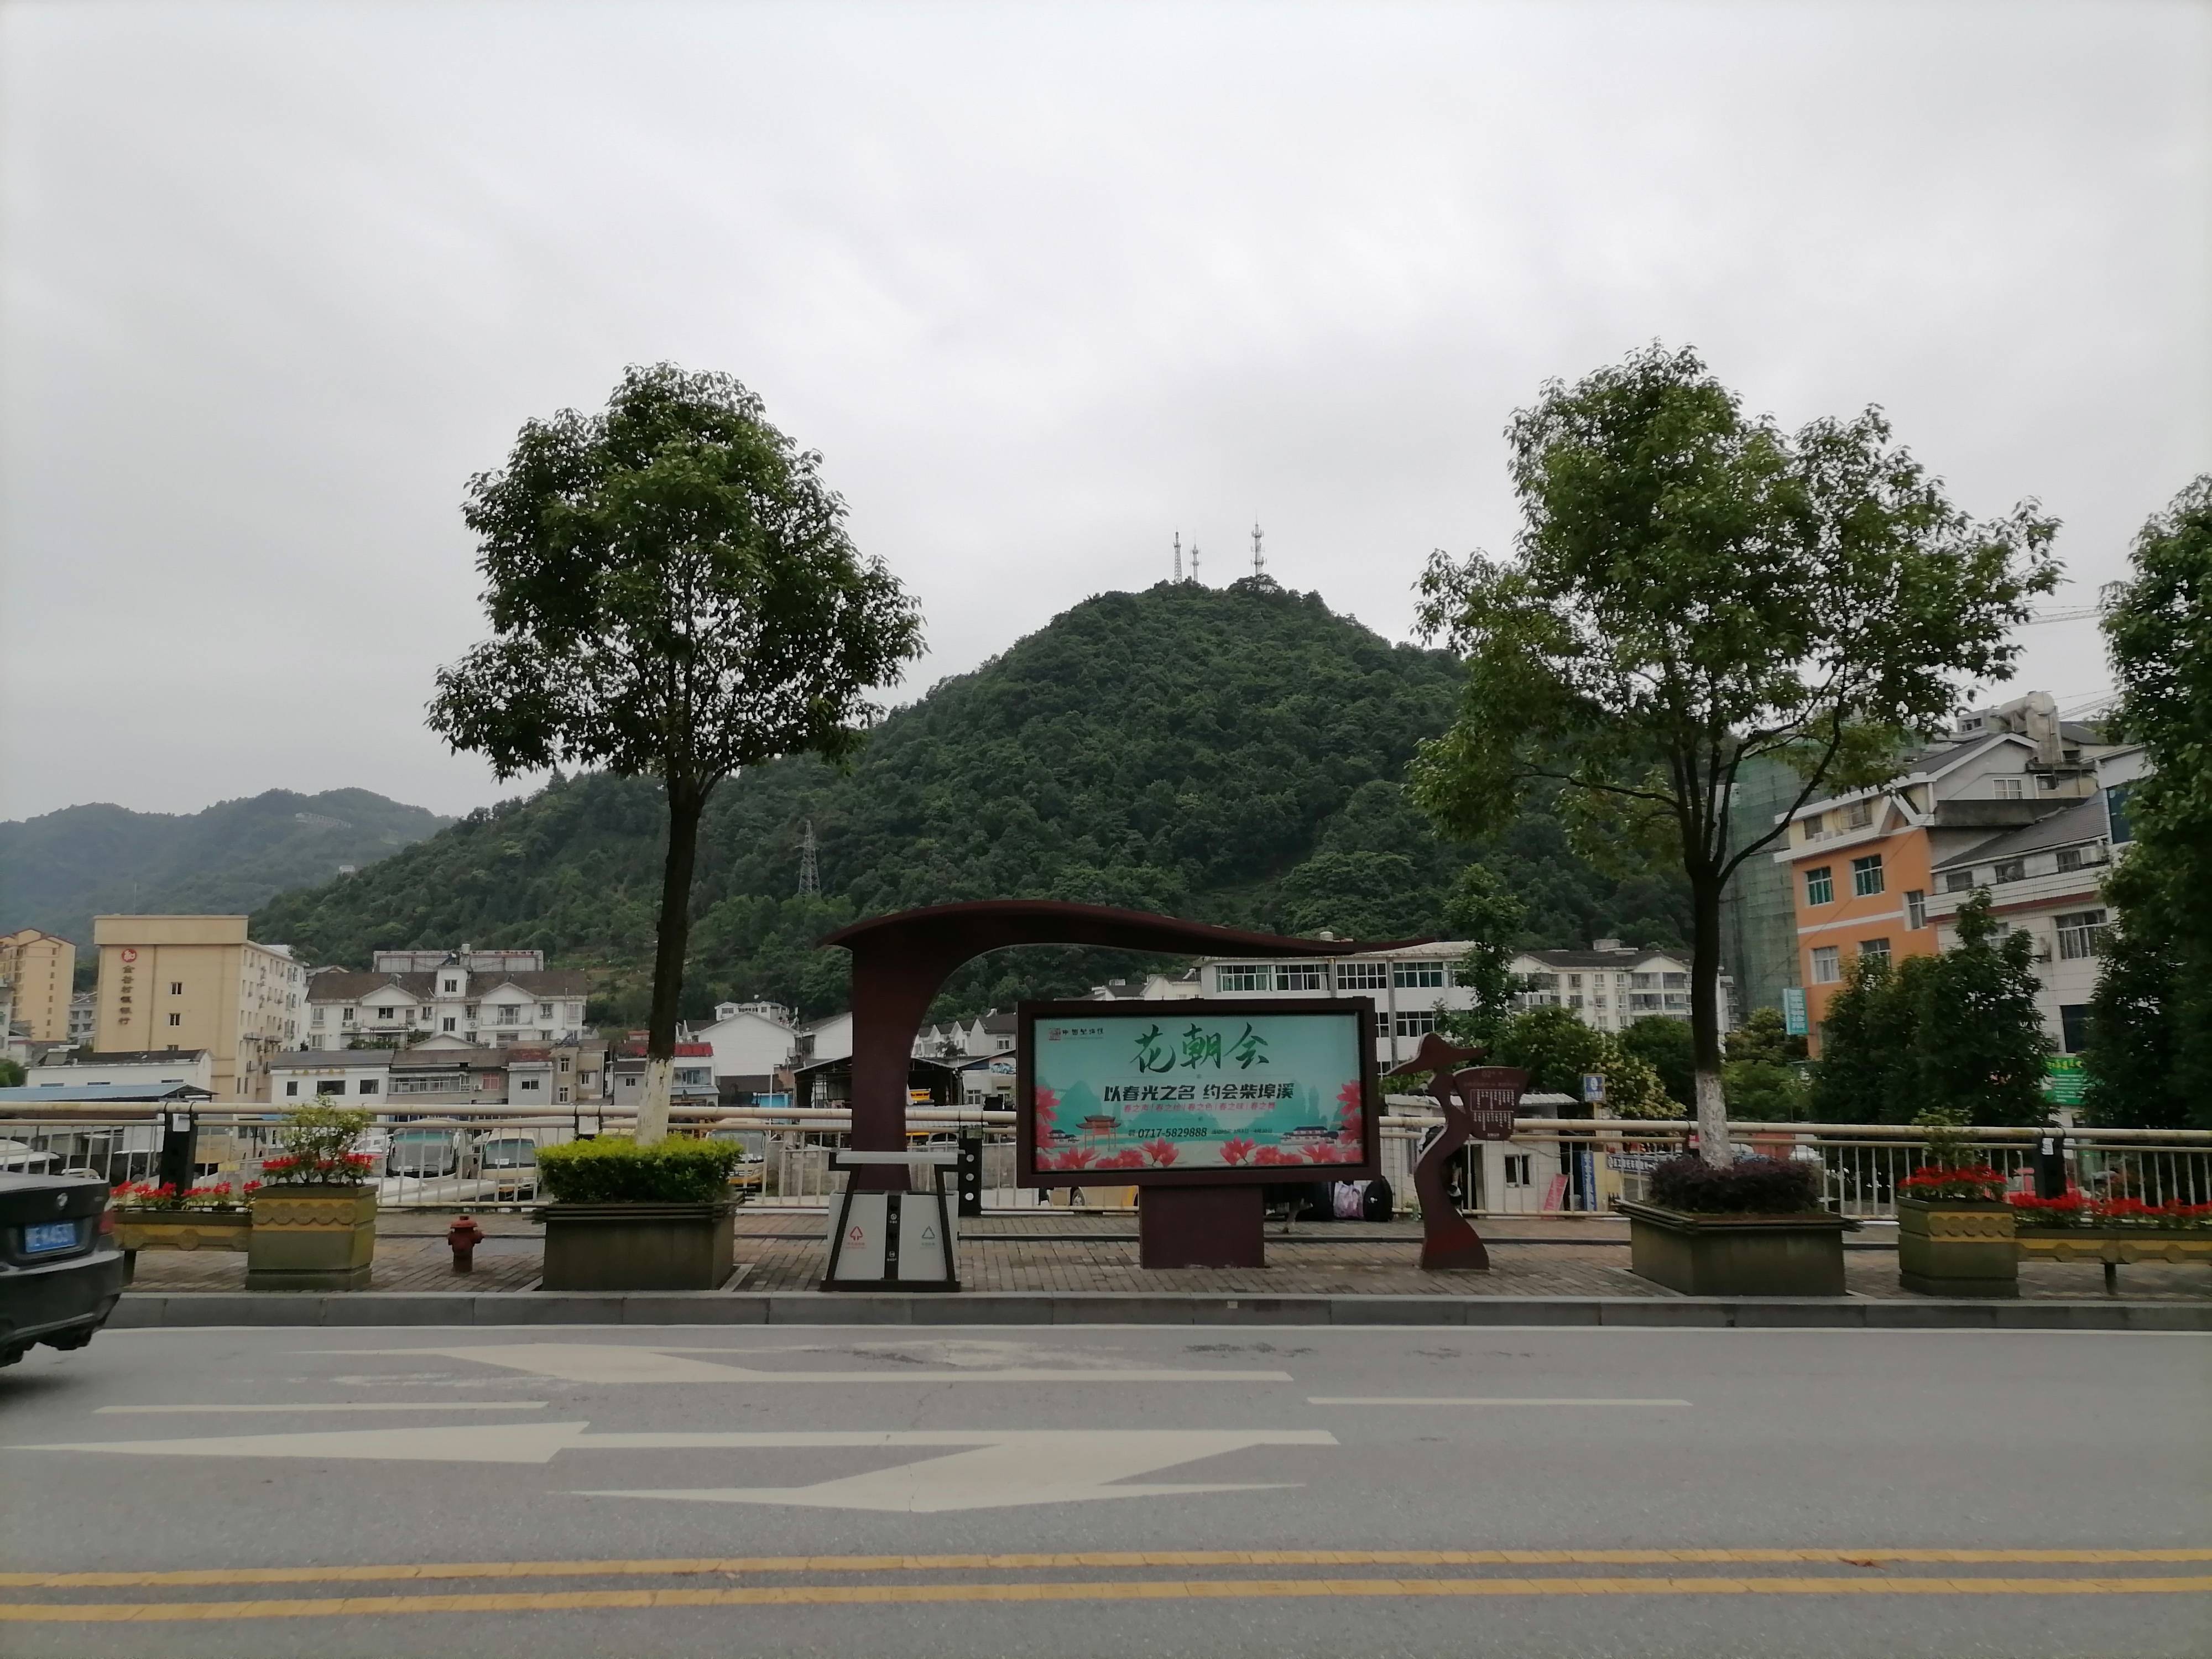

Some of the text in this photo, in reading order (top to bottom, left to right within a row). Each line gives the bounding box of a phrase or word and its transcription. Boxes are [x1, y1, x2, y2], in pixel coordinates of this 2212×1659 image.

[1129, 1021, 1270, 1073] 花朝会
[1104, 1082, 1295, 1102] 以春光之名 约会柴埠溪
[1138, 1127, 1208, 1138] 0717-5829888
